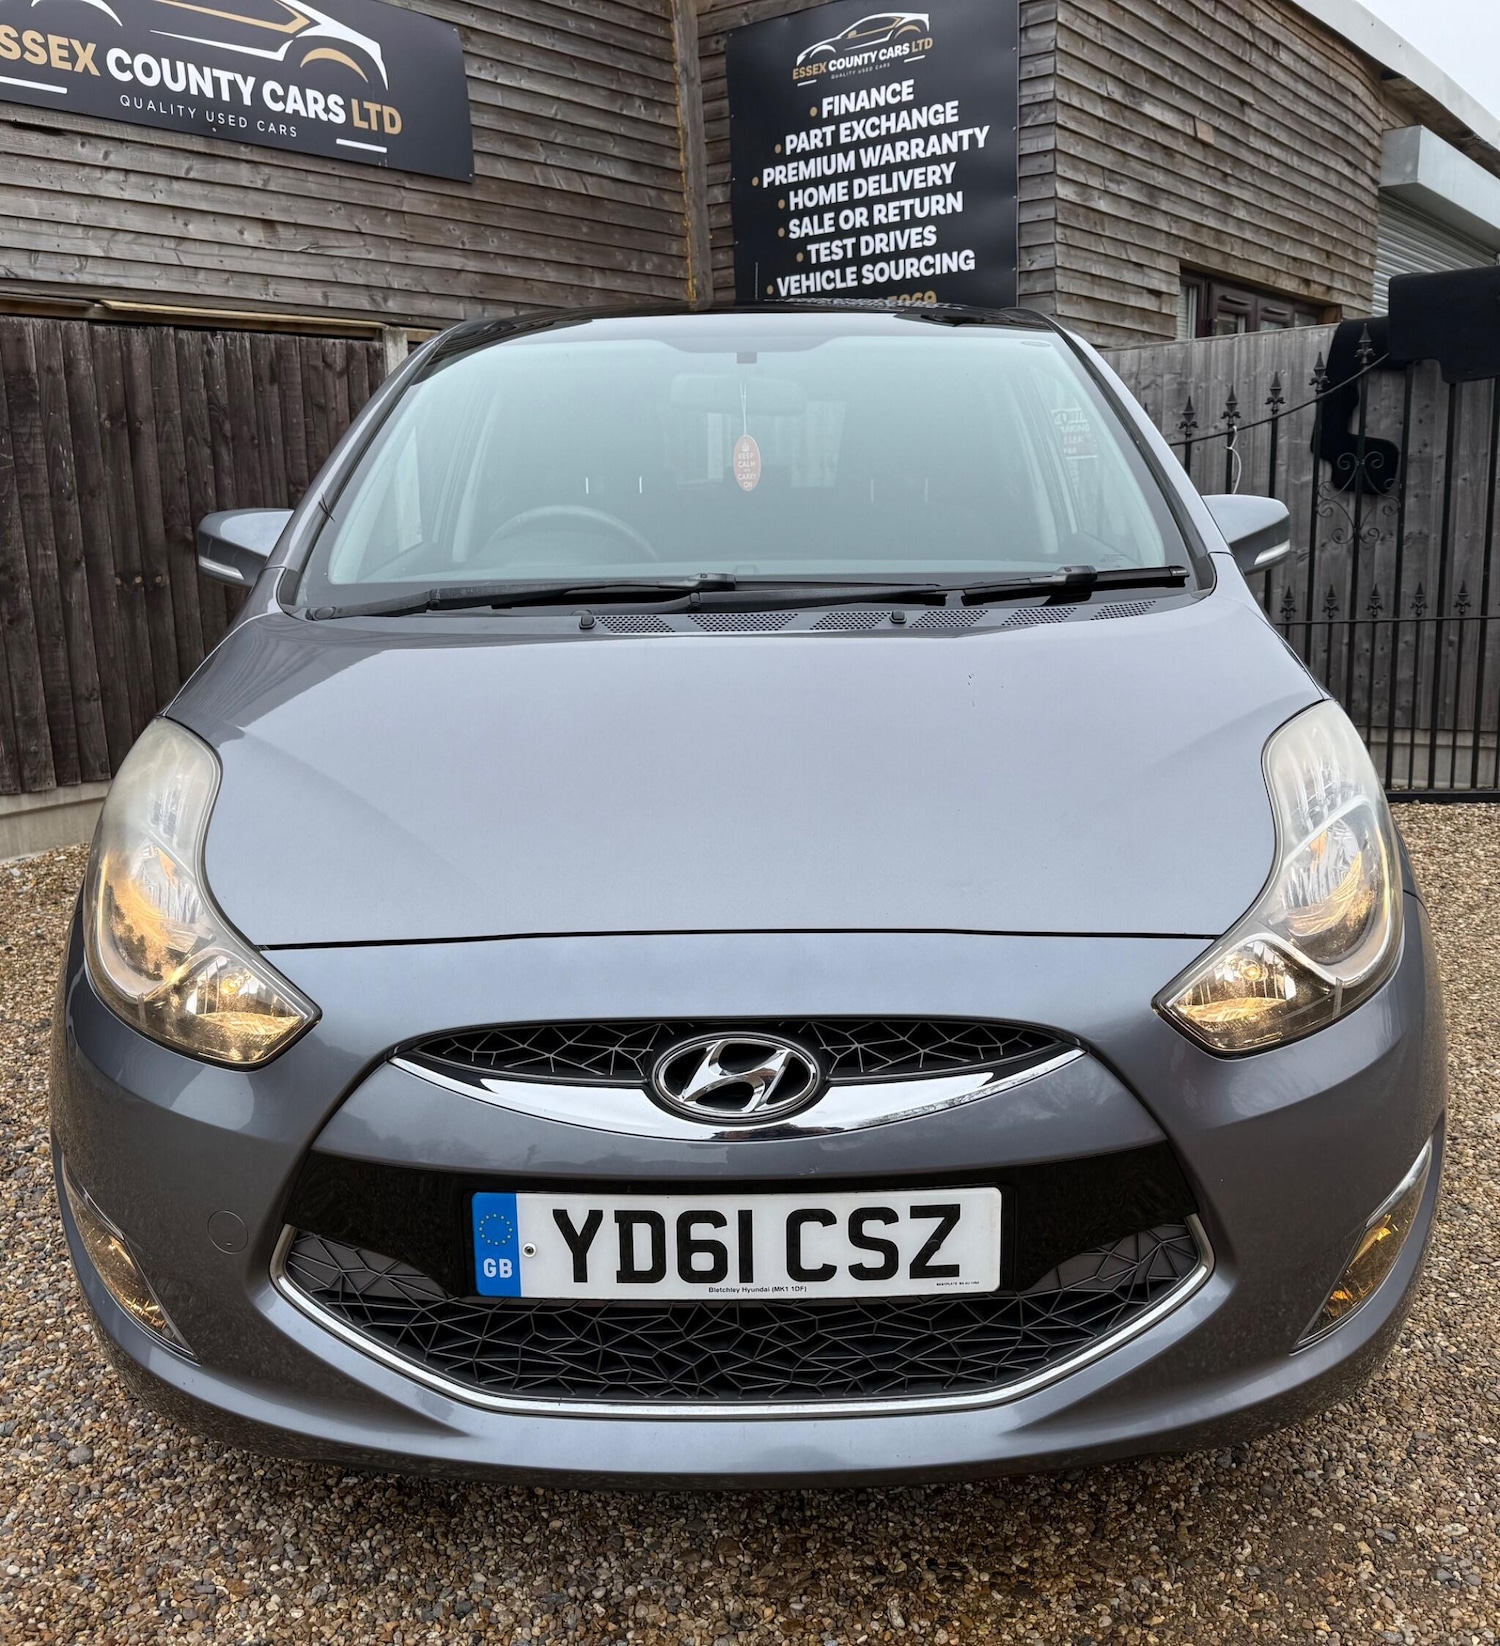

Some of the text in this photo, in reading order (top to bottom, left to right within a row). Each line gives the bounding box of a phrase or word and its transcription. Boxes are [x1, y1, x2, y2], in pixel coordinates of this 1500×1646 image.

[792, 37, 934, 80] ESSEX COUNTY CARS LTD
[106, 47, 256, 106] COUNTY
[262, 80, 347, 124] CARS
[351, 98, 402, 135] LTD
[822, 79, 915, 119] FINANCE
[119, 94, 298, 138] QUALITY USED CARS
[785, 100, 960, 156] PART EXCHANGE
[762, 125, 991, 188] PREMIUM WARRANTY
[789, 161, 957, 211] HOME DELIVERY
[788, 191, 964, 240] SALE OR RETURN
[807, 225, 937, 265] TEST DRIVES
[777, 266, 858, 298] VEHICLE
[861, 249, 976, 285] SOURCING
[743, 481, 753, 489] ON
[552, 1203, 962, 1284] YD61 CSZ
[483, 1258, 513, 1279] GB
[708, 1285, 807, 1294] Bletchley Hyundai (MK1 1DF)
